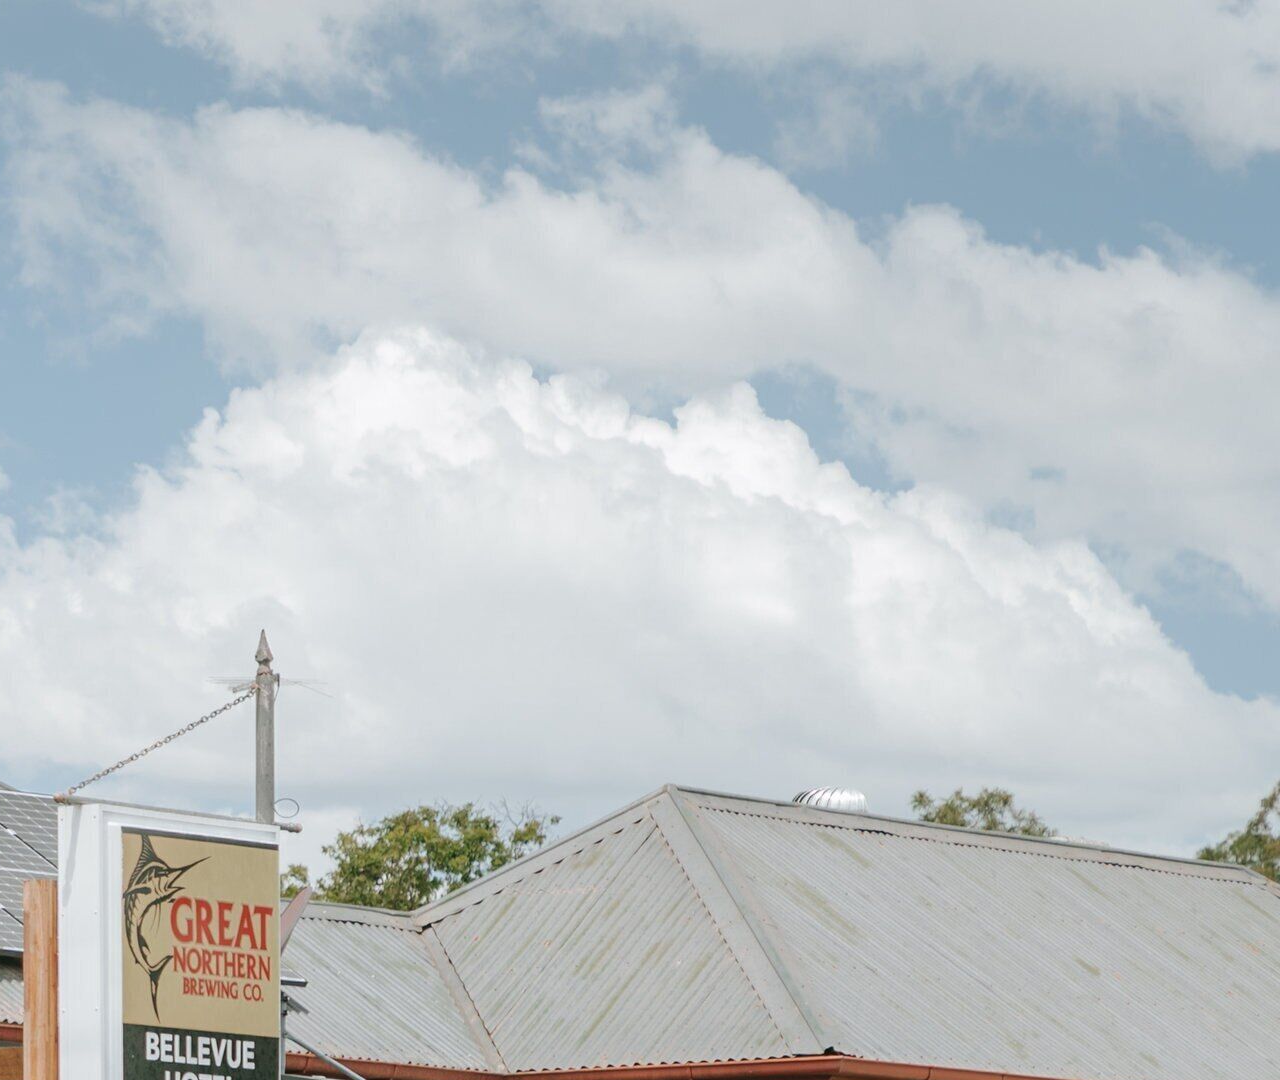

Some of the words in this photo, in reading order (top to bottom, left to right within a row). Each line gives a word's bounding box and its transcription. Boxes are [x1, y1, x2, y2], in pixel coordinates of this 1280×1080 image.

[171, 896, 273, 951] GREAT
[173, 946, 271, 982] NORTHERN
[183, 977, 238, 999] BREWING
[243, 983, 264, 1002] CO.
[145, 1031, 256, 1070] BELLEVUE
